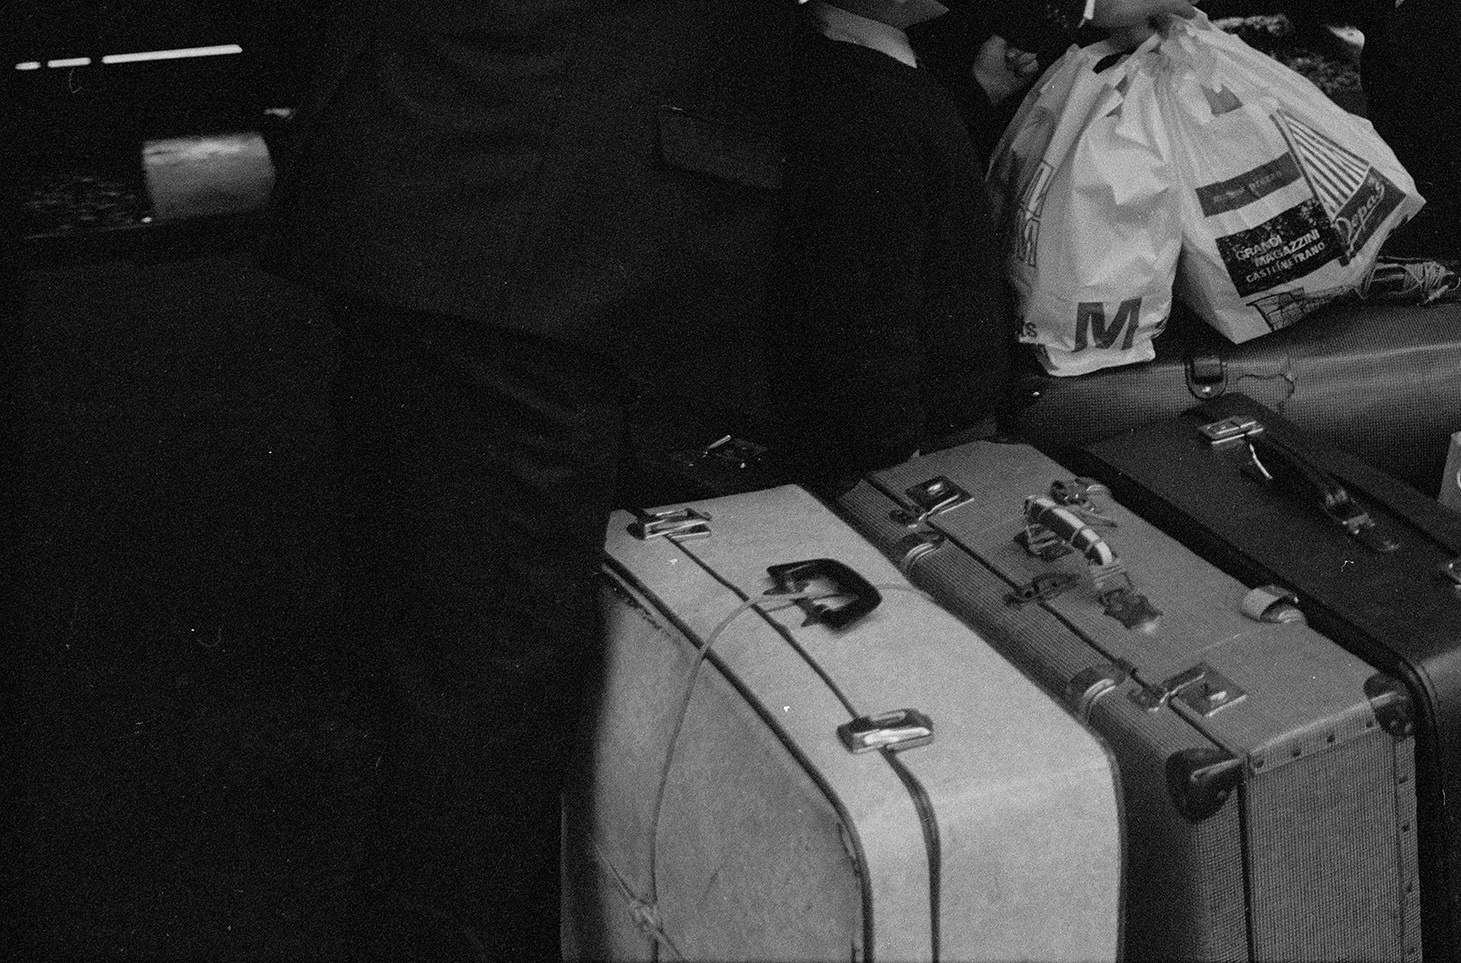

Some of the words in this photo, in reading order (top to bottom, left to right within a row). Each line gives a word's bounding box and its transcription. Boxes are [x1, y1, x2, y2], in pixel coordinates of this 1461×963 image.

[1235, 234, 1284, 262] GRANDI
[1254, 228, 1321, 268] MAGAZZINI
[1072, 297, 1143, 353] M
